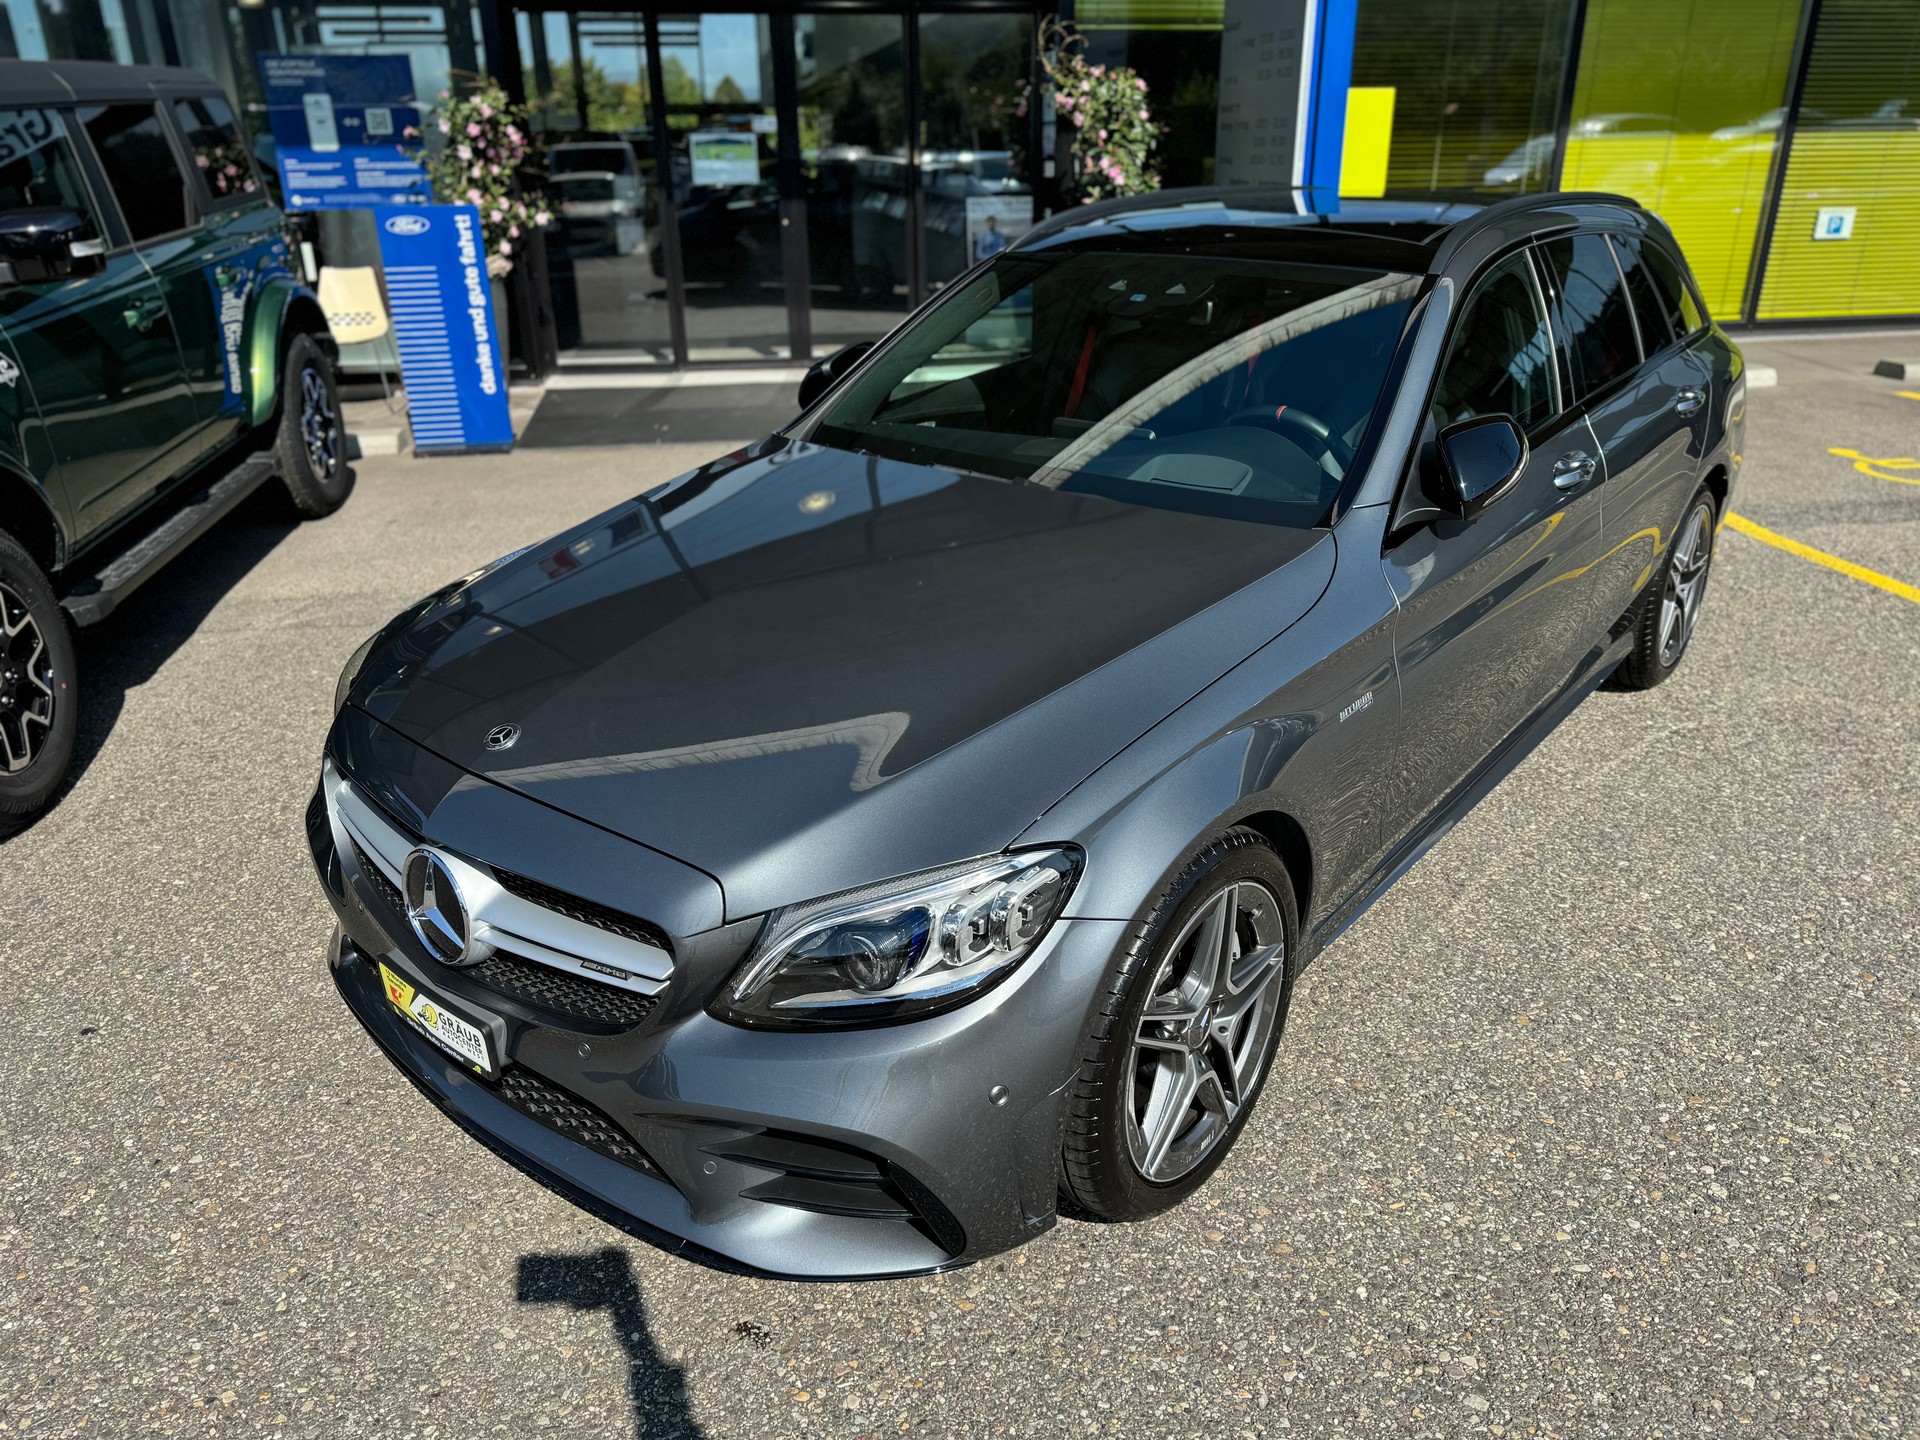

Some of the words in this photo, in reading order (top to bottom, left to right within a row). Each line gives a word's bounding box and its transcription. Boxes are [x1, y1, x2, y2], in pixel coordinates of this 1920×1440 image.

[464, 266, 487, 307] gute
[467, 307, 489, 342] und
[475, 342, 496, 395] danke
[1339, 690, 1373, 721] BITURBO
[438, 1012, 481, 1047] GRÄUB
[441, 1025, 483, 1056] AUTOCENTER
[440, 1043, 464, 1062] Center
